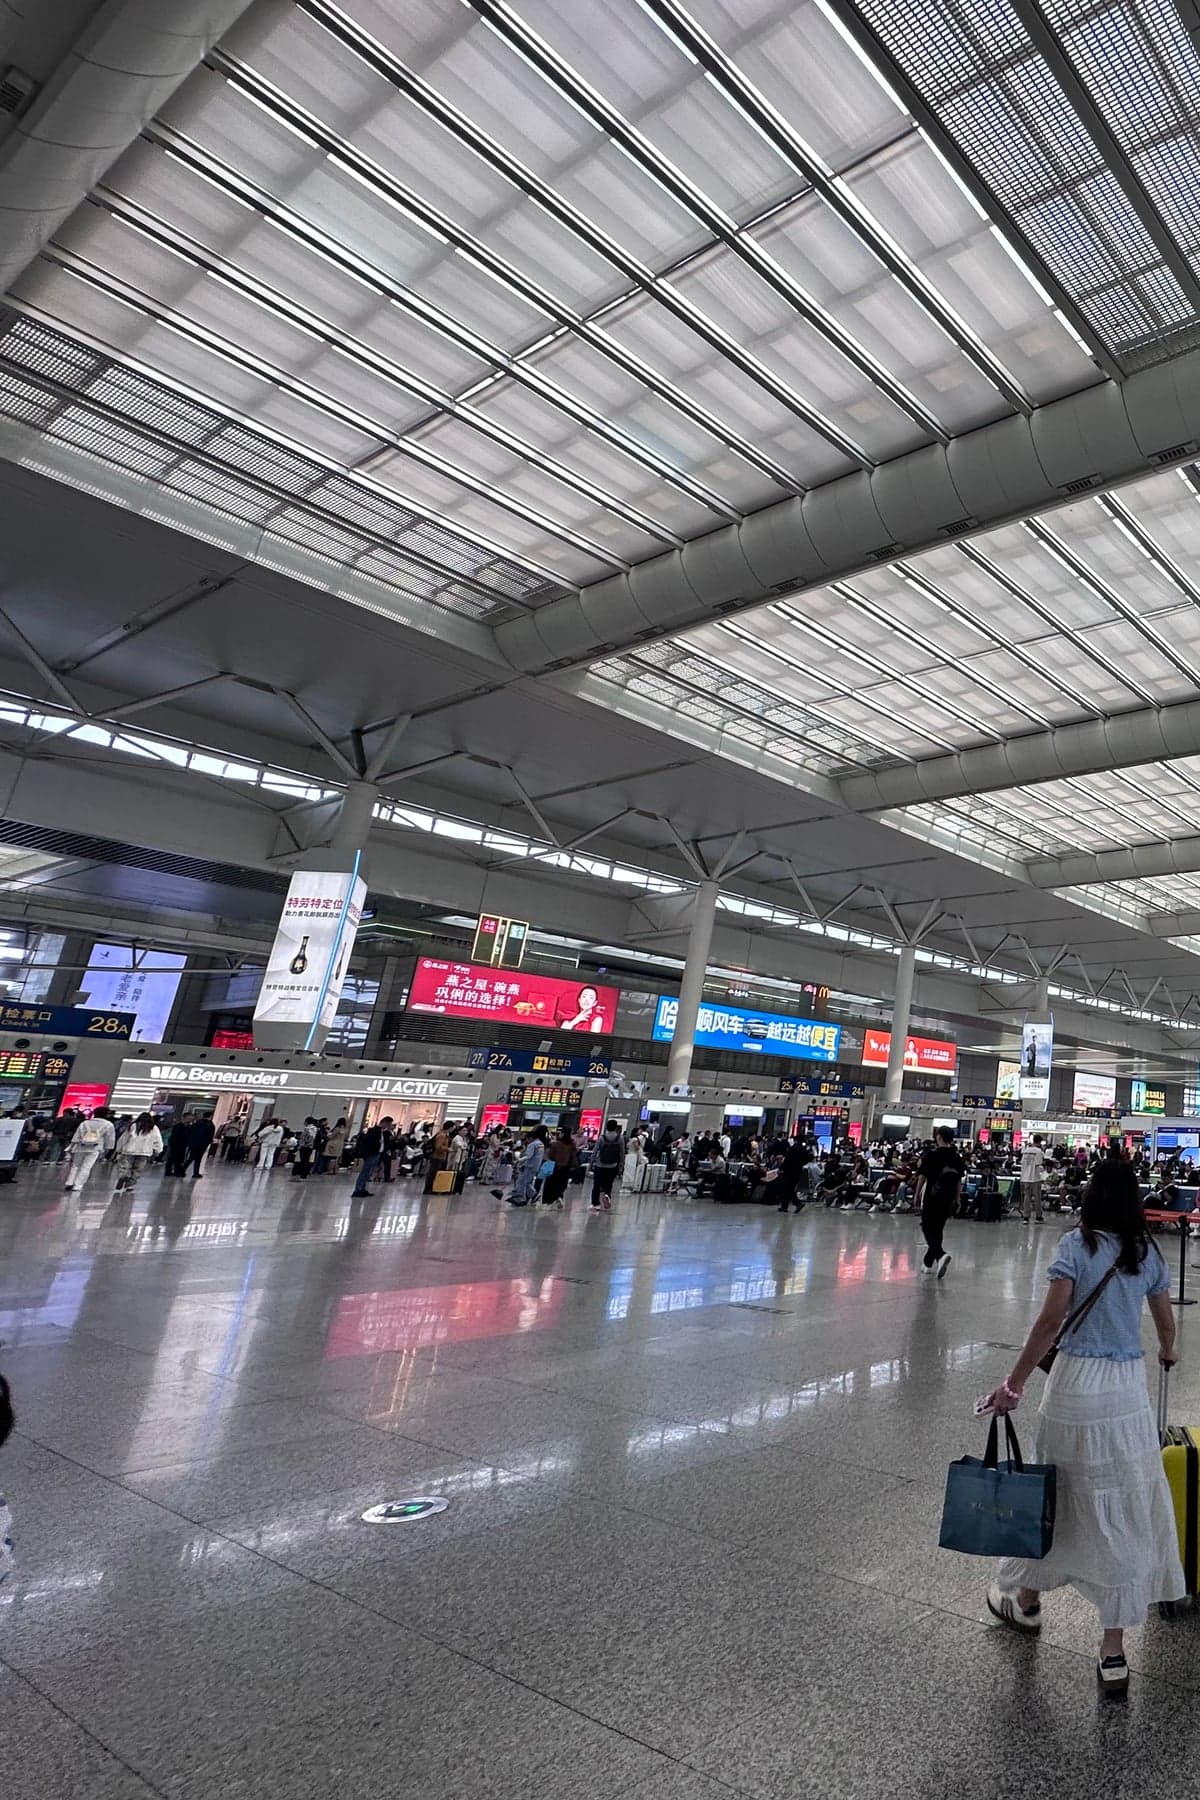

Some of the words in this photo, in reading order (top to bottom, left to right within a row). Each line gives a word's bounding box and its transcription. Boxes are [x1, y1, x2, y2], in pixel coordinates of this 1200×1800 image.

[287, 897, 344, 910] 特劳特定位
[444, 973, 521, 996] 燕之屋·碗燕
[434, 986, 512, 1007] 巩俐的选择!
[5, 1007, 53, 1022] 检票口
[87, 1015, 129, 1034] 28A
[657, 1000, 745, 1035] 哈顺风车
[766, 1021, 838, 1052] 越远越便宜
[45, 1058, 69, 1069] 28A
[488, 1053, 513, 1067] 27A
[588, 1062, 609, 1075] 26A
[188, 1066, 278, 1086] Beneunder
[366, 1079, 389, 1093] JU
[391, 1080, 449, 1096] ACTIVE
